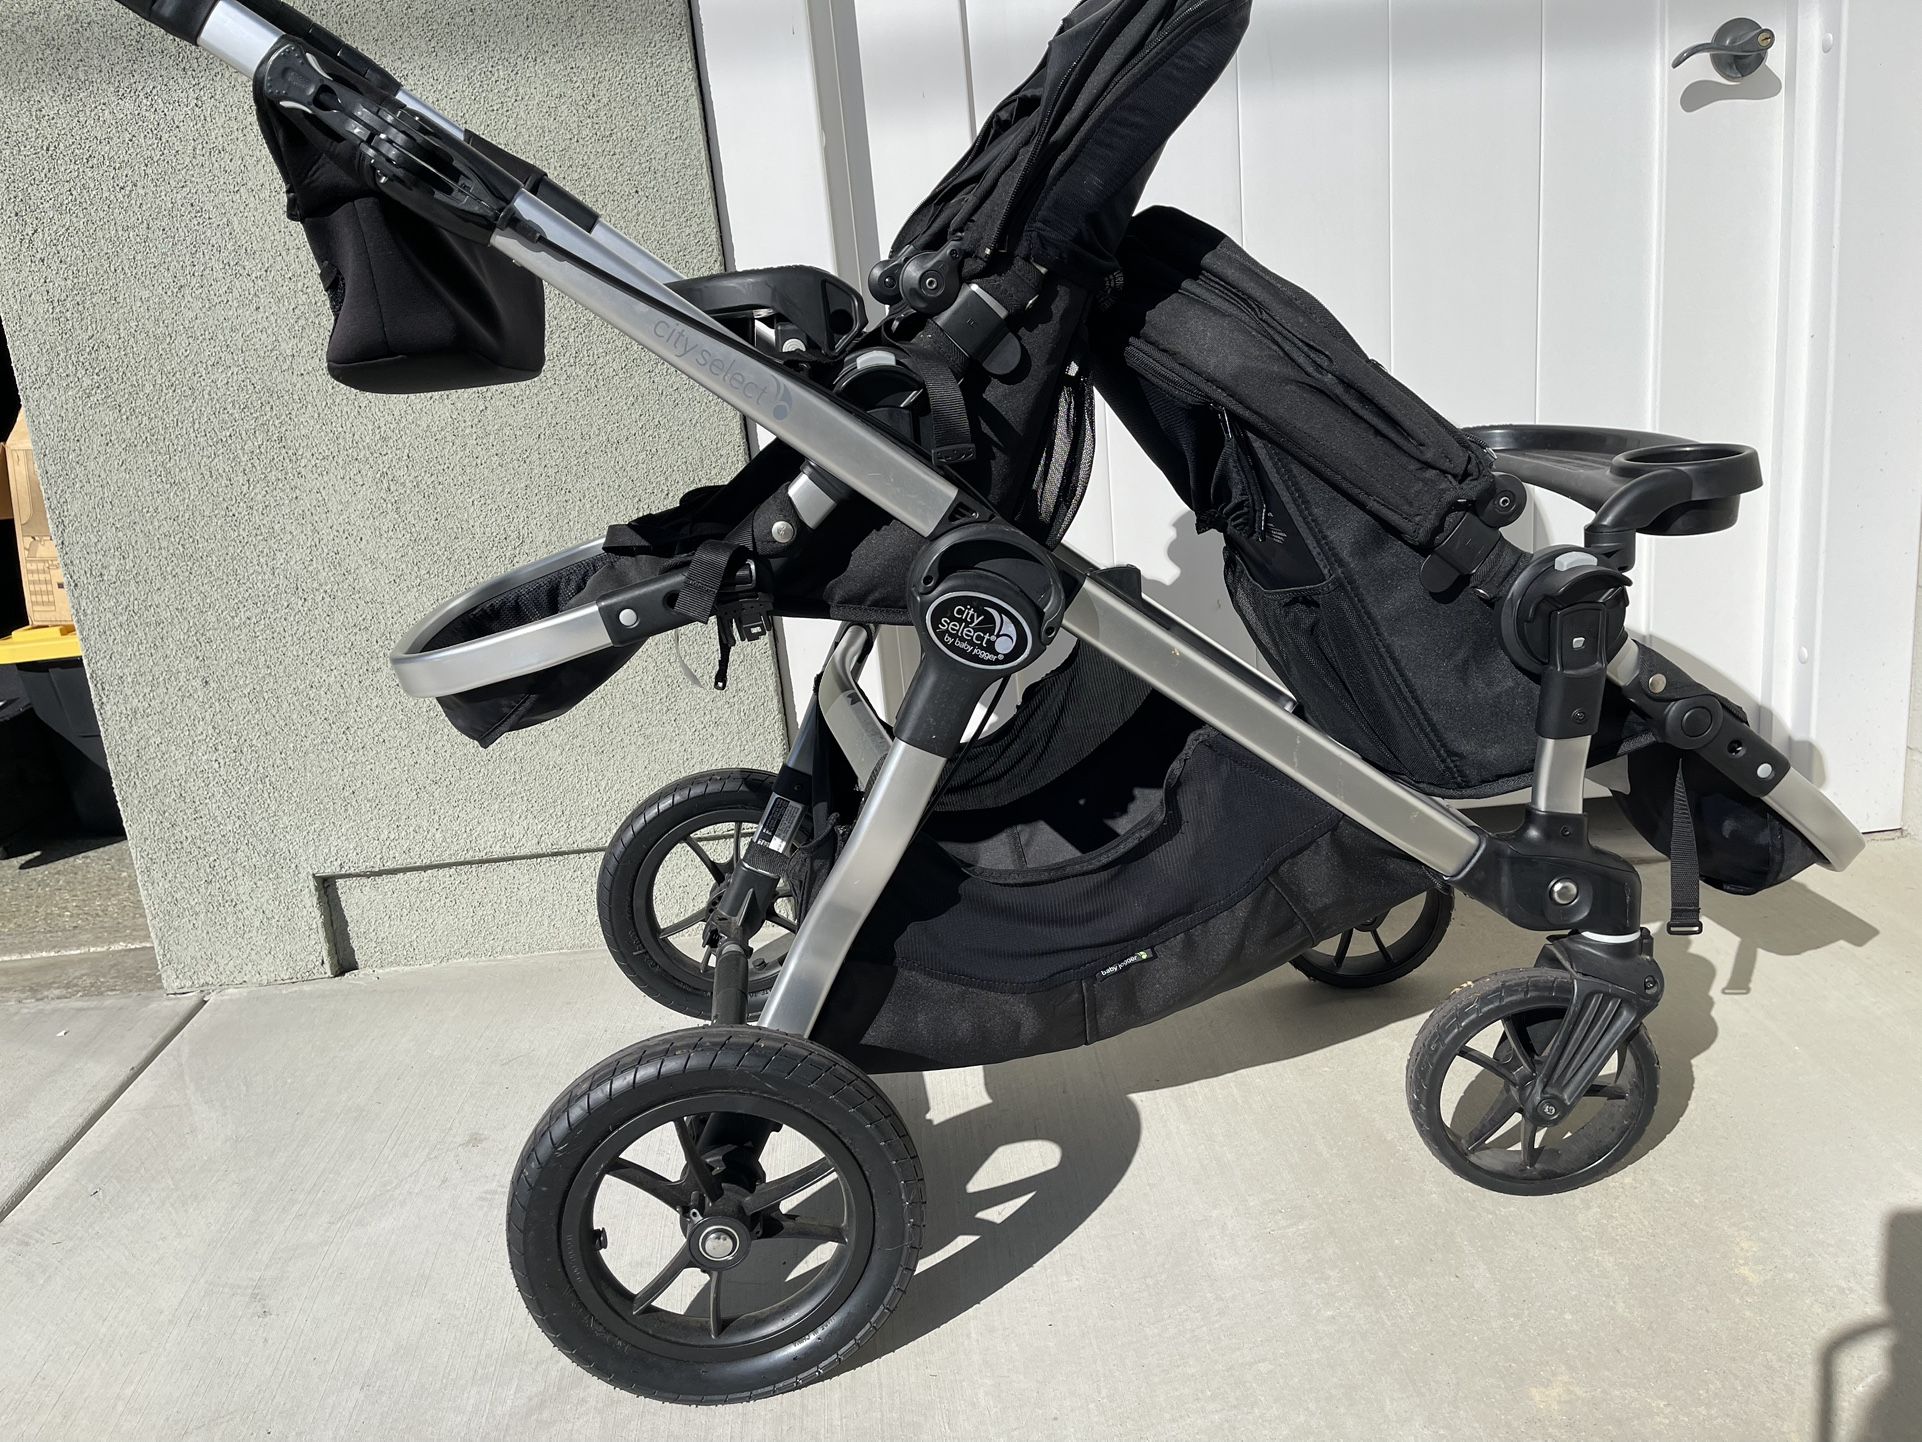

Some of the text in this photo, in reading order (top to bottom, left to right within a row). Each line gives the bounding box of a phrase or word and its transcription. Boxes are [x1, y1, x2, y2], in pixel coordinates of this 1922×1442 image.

[653, 320, 769, 405] city select
[953, 605, 984, 627] city
[943, 633, 953, 645] by
[954, 638, 973, 653] baby
[1100, 955, 1138, 976] baby jogger
